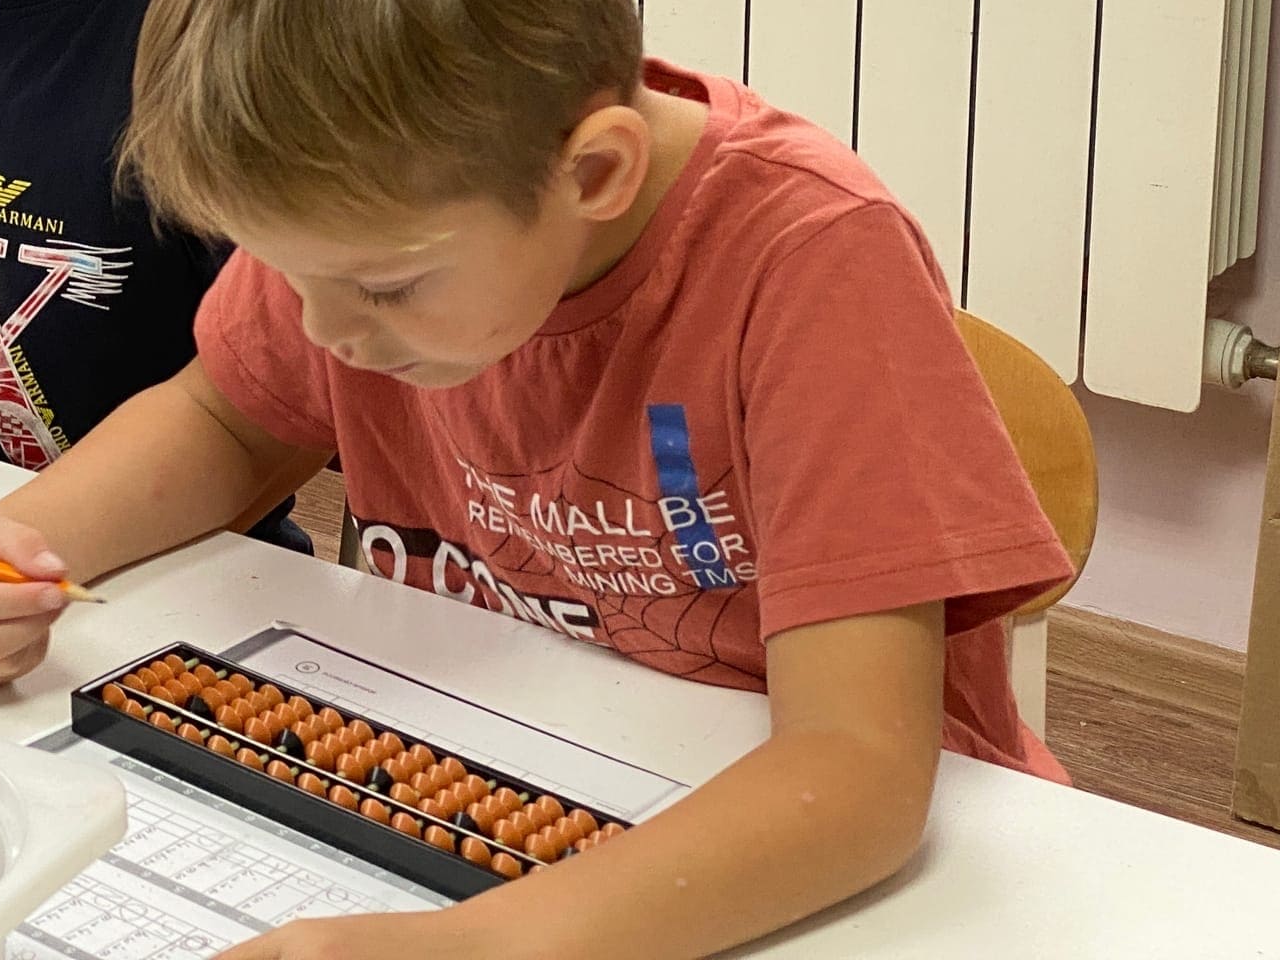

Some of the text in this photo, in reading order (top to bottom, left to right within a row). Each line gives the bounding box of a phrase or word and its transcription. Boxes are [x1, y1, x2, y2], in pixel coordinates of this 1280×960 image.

[9, 344, 48, 408] ARMANI
[530, 493, 651, 537] MALL
[657, 490, 736, 533] BE
[670, 533, 750, 566] FOR
[564, 565, 677, 596] MINING
